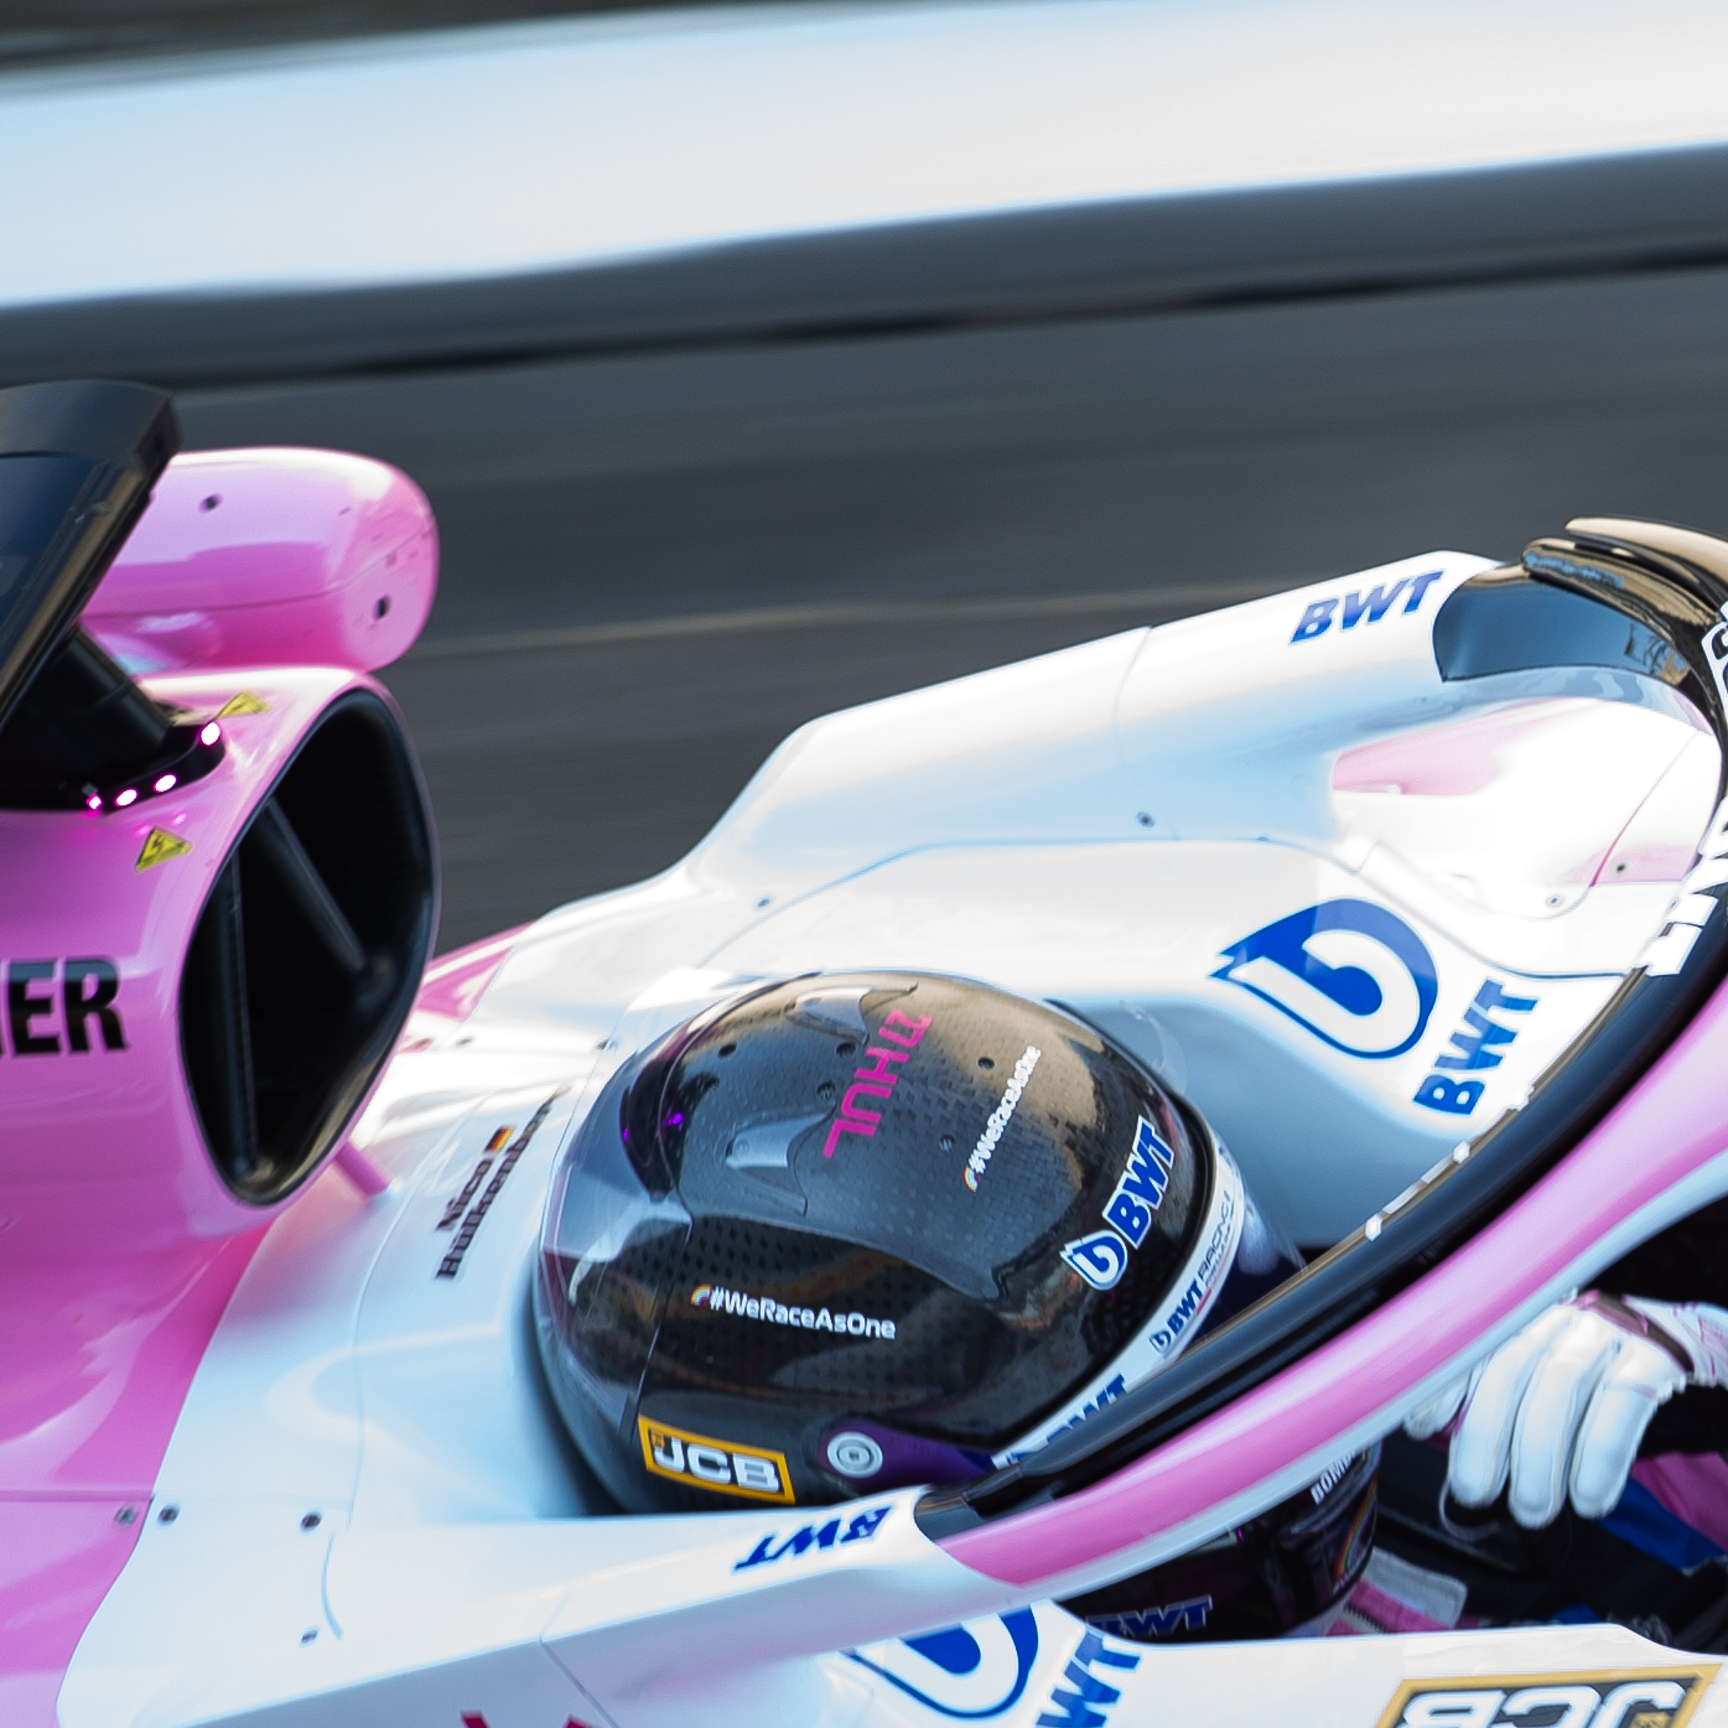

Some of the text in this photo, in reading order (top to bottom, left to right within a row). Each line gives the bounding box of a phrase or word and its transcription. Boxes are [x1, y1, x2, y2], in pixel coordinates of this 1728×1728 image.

[1290, 570, 1445, 635] BWT
[0, 958, 128, 1058] ER
[1412, 979, 1538, 1115] BWT
[967, 1045, 1042, 1175] #WeRaceAsOne
[1102, 1115, 1174, 1250] BWT
[709, 1285, 896, 1340] #WeRaceAsOne
[1166, 1279, 1203, 1331] BWT
[652, 1436, 781, 1493] JCB
[733, 1506, 891, 1571] BWT
